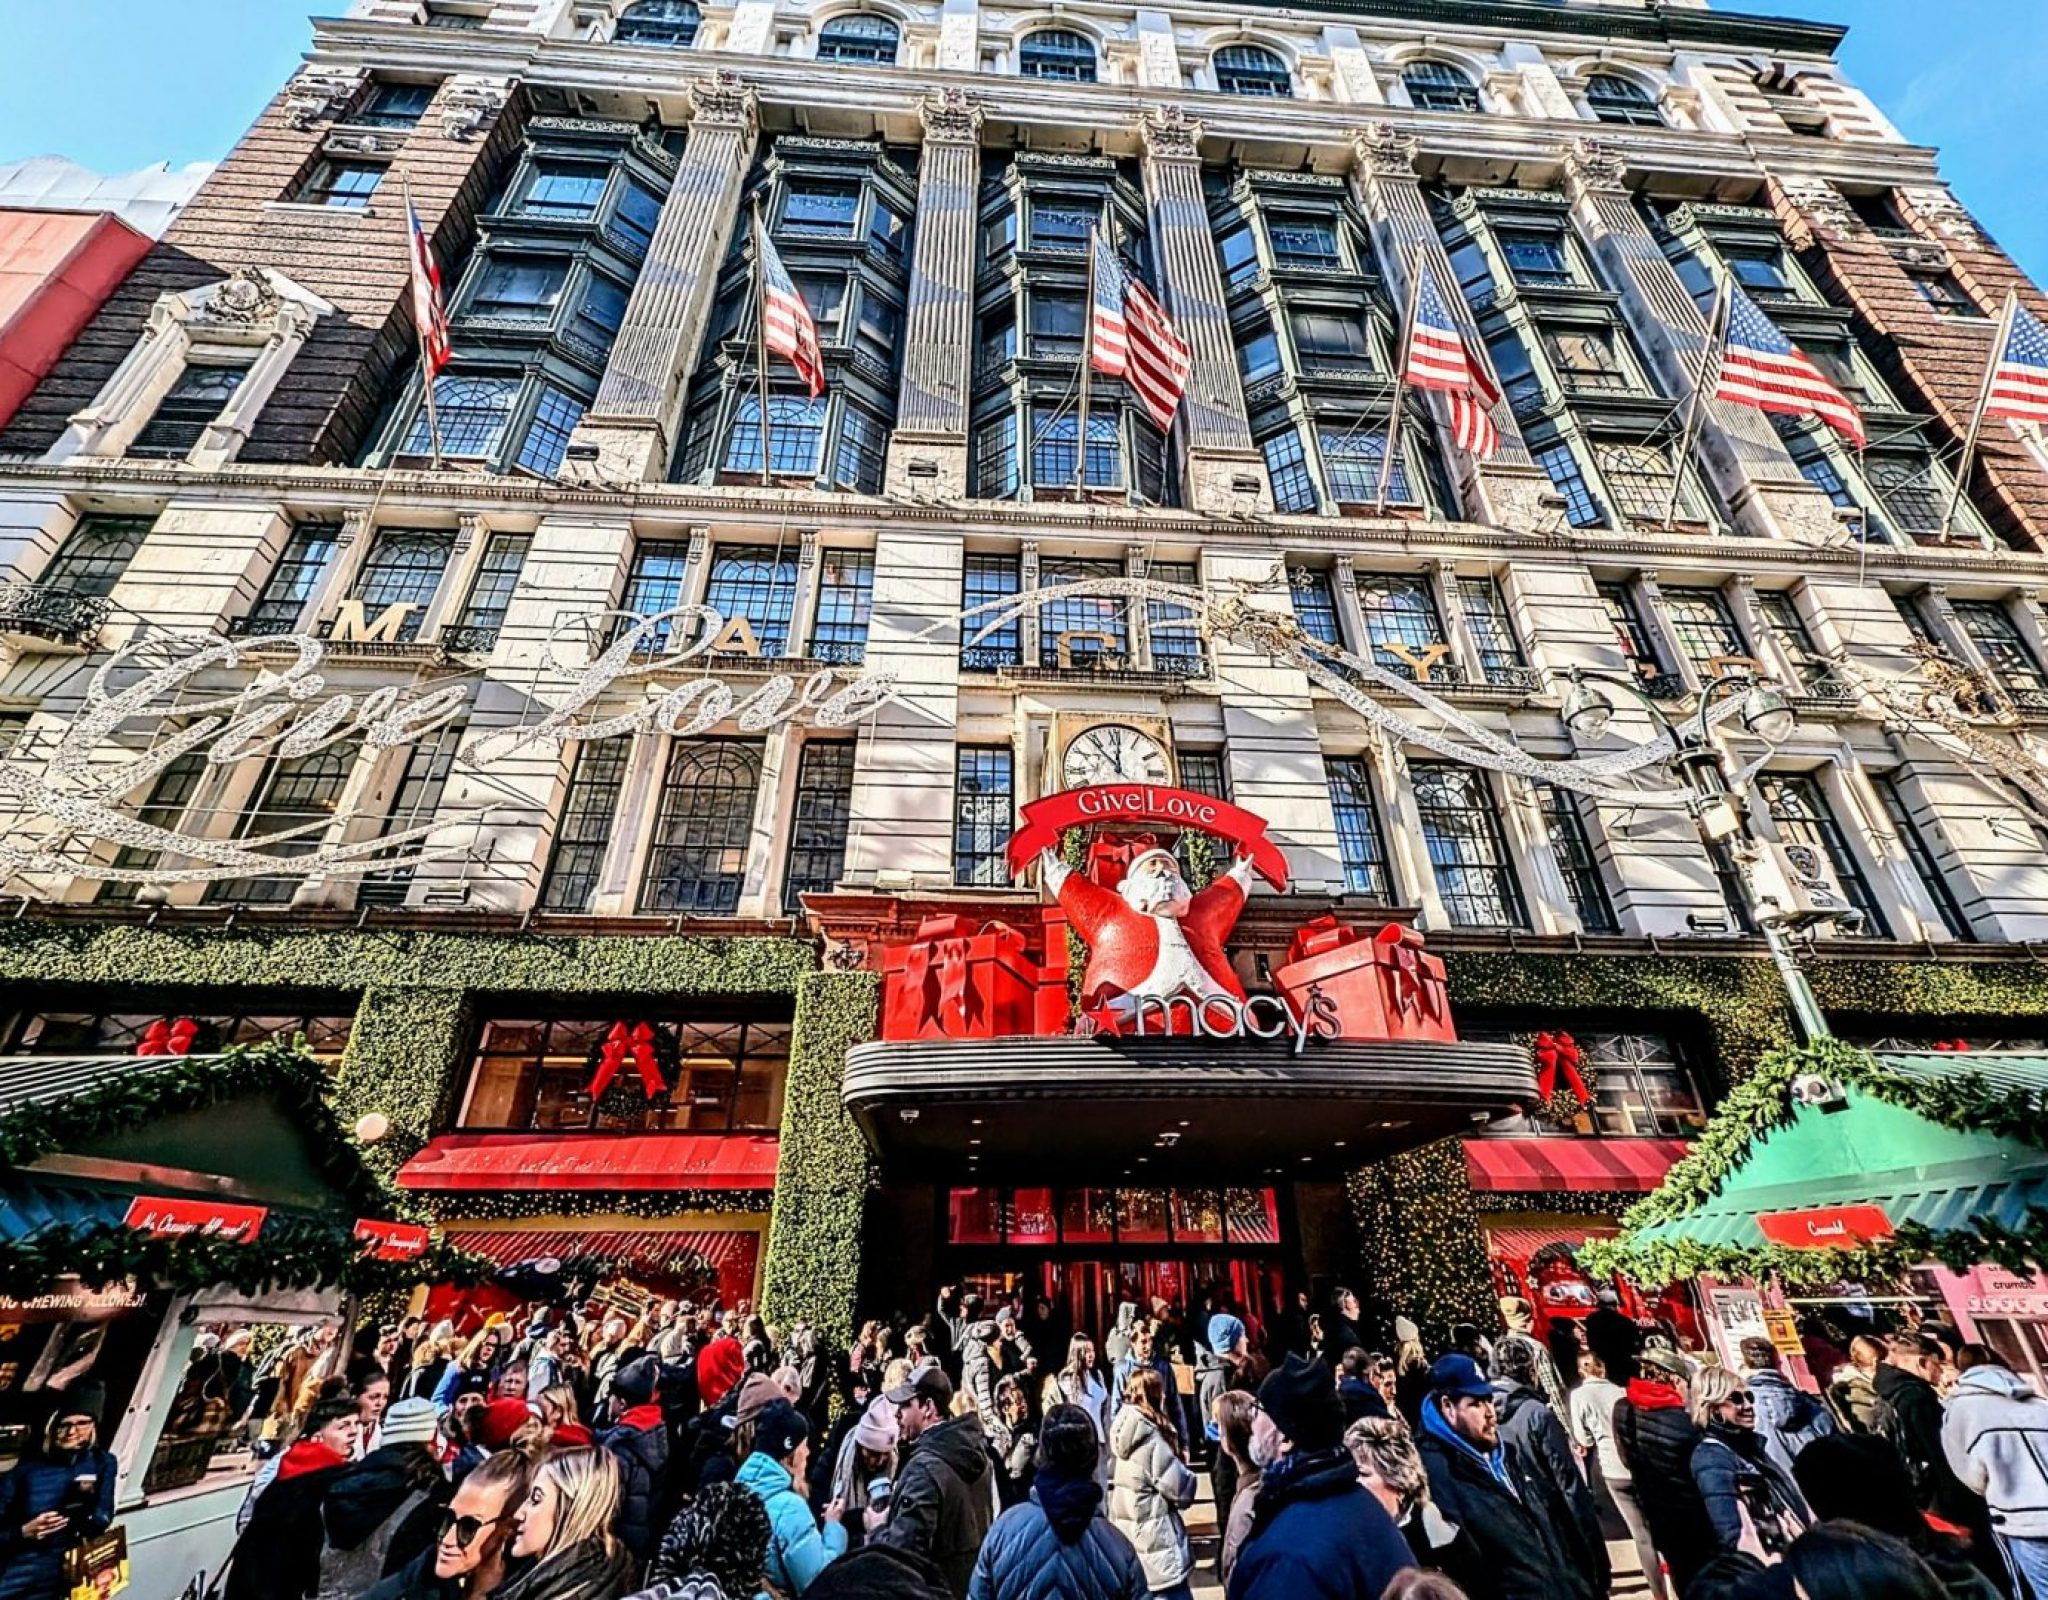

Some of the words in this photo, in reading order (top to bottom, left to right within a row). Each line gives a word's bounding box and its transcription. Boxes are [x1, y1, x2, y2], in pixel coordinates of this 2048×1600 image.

[48, 633, 469, 803] Give
[456, 604, 902, 768] Love
[1078, 789, 1142, 814] Give
[1146, 789, 1216, 822] Love
